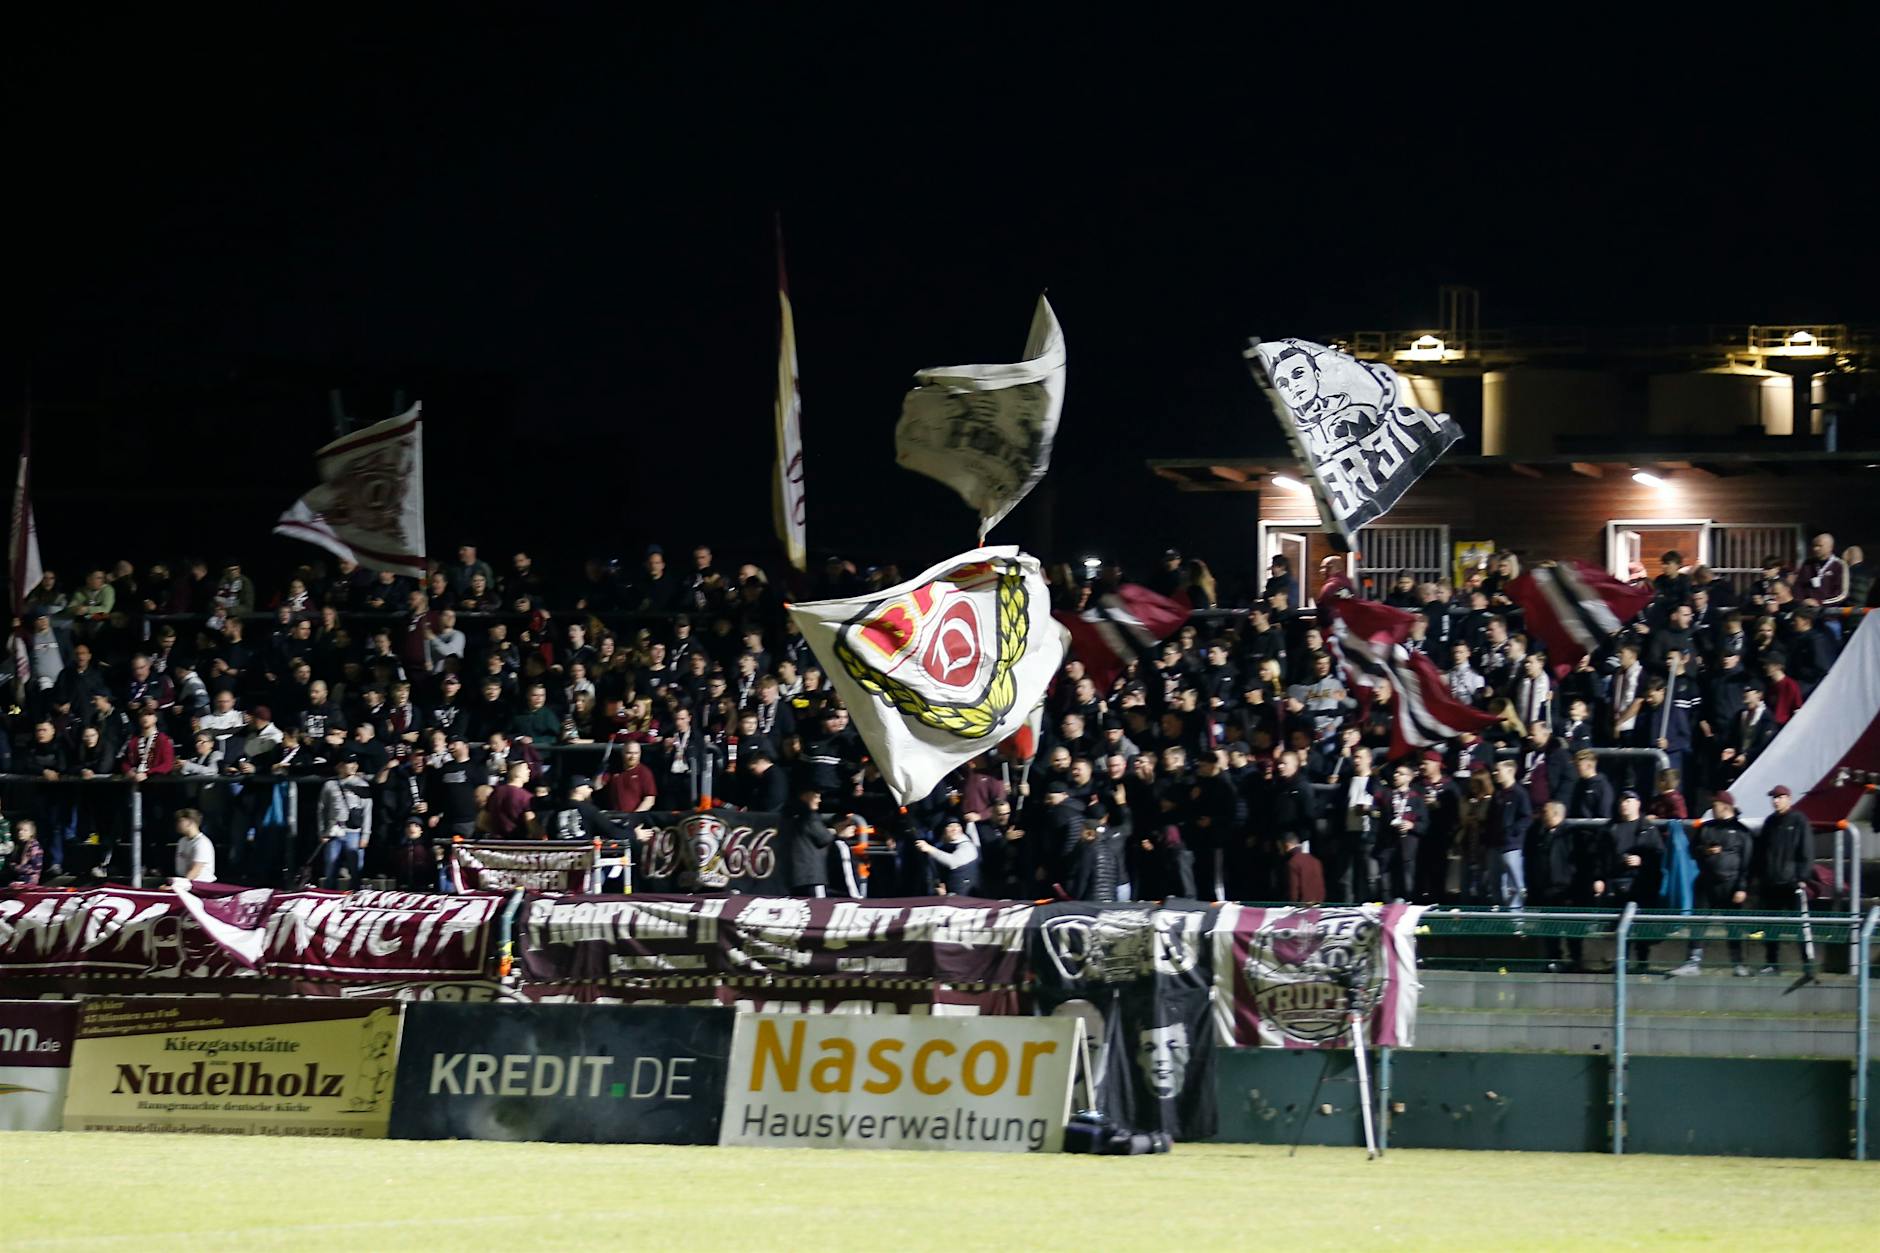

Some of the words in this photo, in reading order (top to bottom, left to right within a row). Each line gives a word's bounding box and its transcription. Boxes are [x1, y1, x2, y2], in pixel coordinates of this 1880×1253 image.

[164, 1036, 301, 1057] Kiezgaststätte
[748, 1020, 1057, 1096] Nascor
[111, 1061, 345, 1097] Nudelholz
[428, 1053, 696, 1100] KREDIT.DE
[222, 1102, 272, 1112] deutsche
[742, 1104, 1048, 1150] Hausverwaltung
